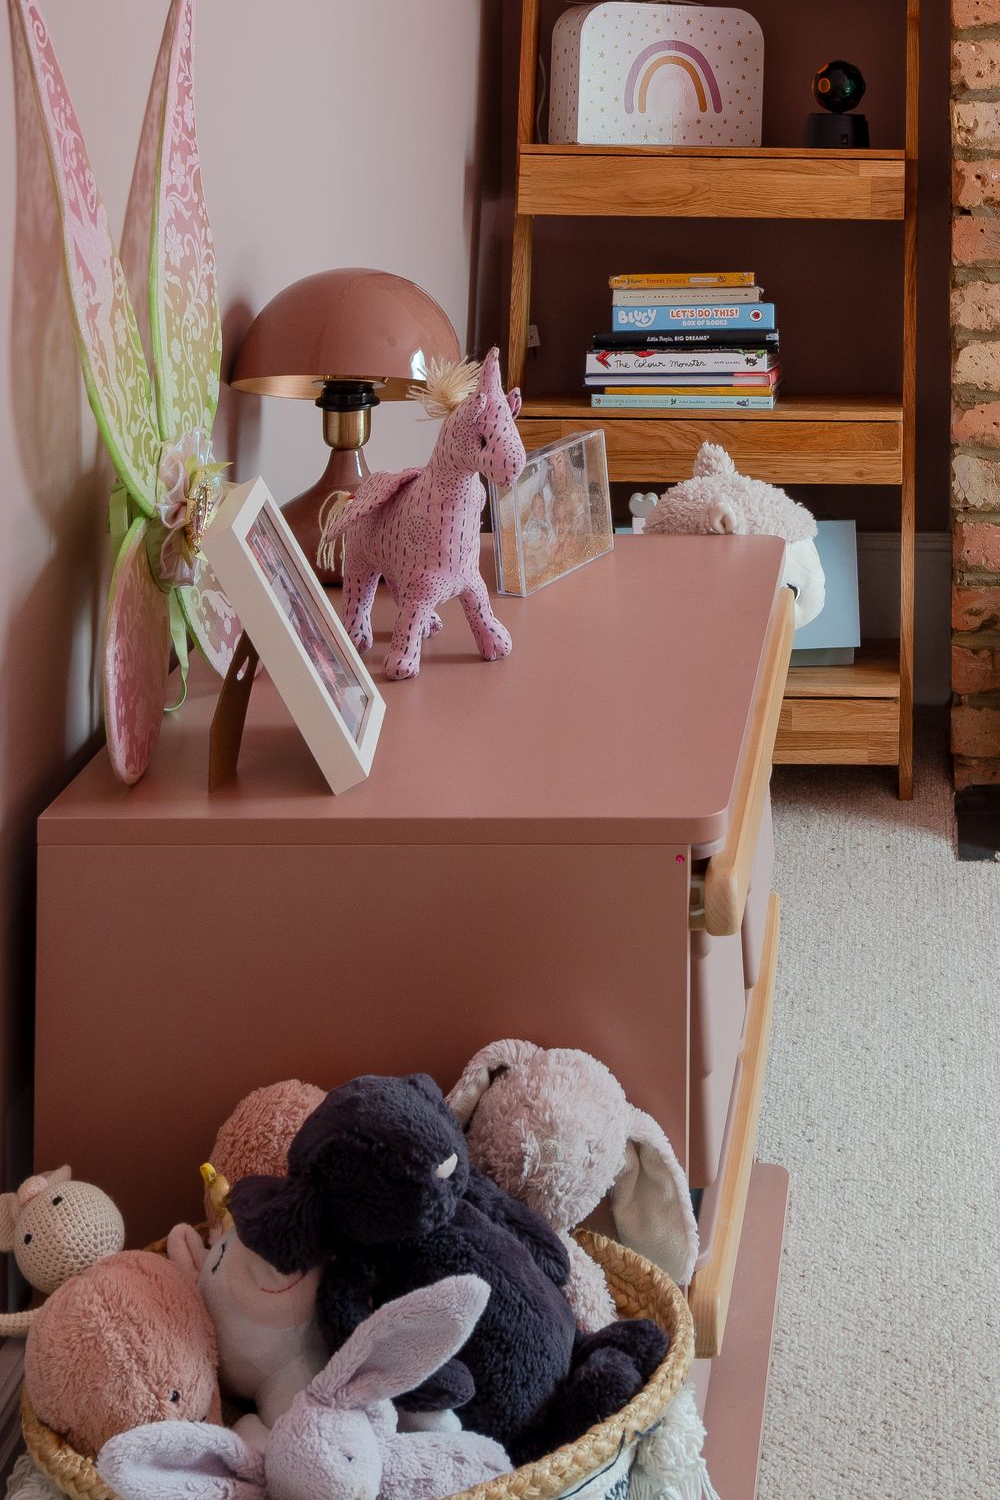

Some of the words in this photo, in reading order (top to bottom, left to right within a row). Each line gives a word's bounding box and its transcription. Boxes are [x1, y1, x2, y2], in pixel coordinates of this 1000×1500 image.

[669, 309, 695, 319] LET'S
[697, 309, 711, 318] DO
[713, 308, 739, 318] THIS!
[614, 360, 631, 369] The
[633, 360, 666, 368] Colour
[670, 359, 707, 368] Monster
